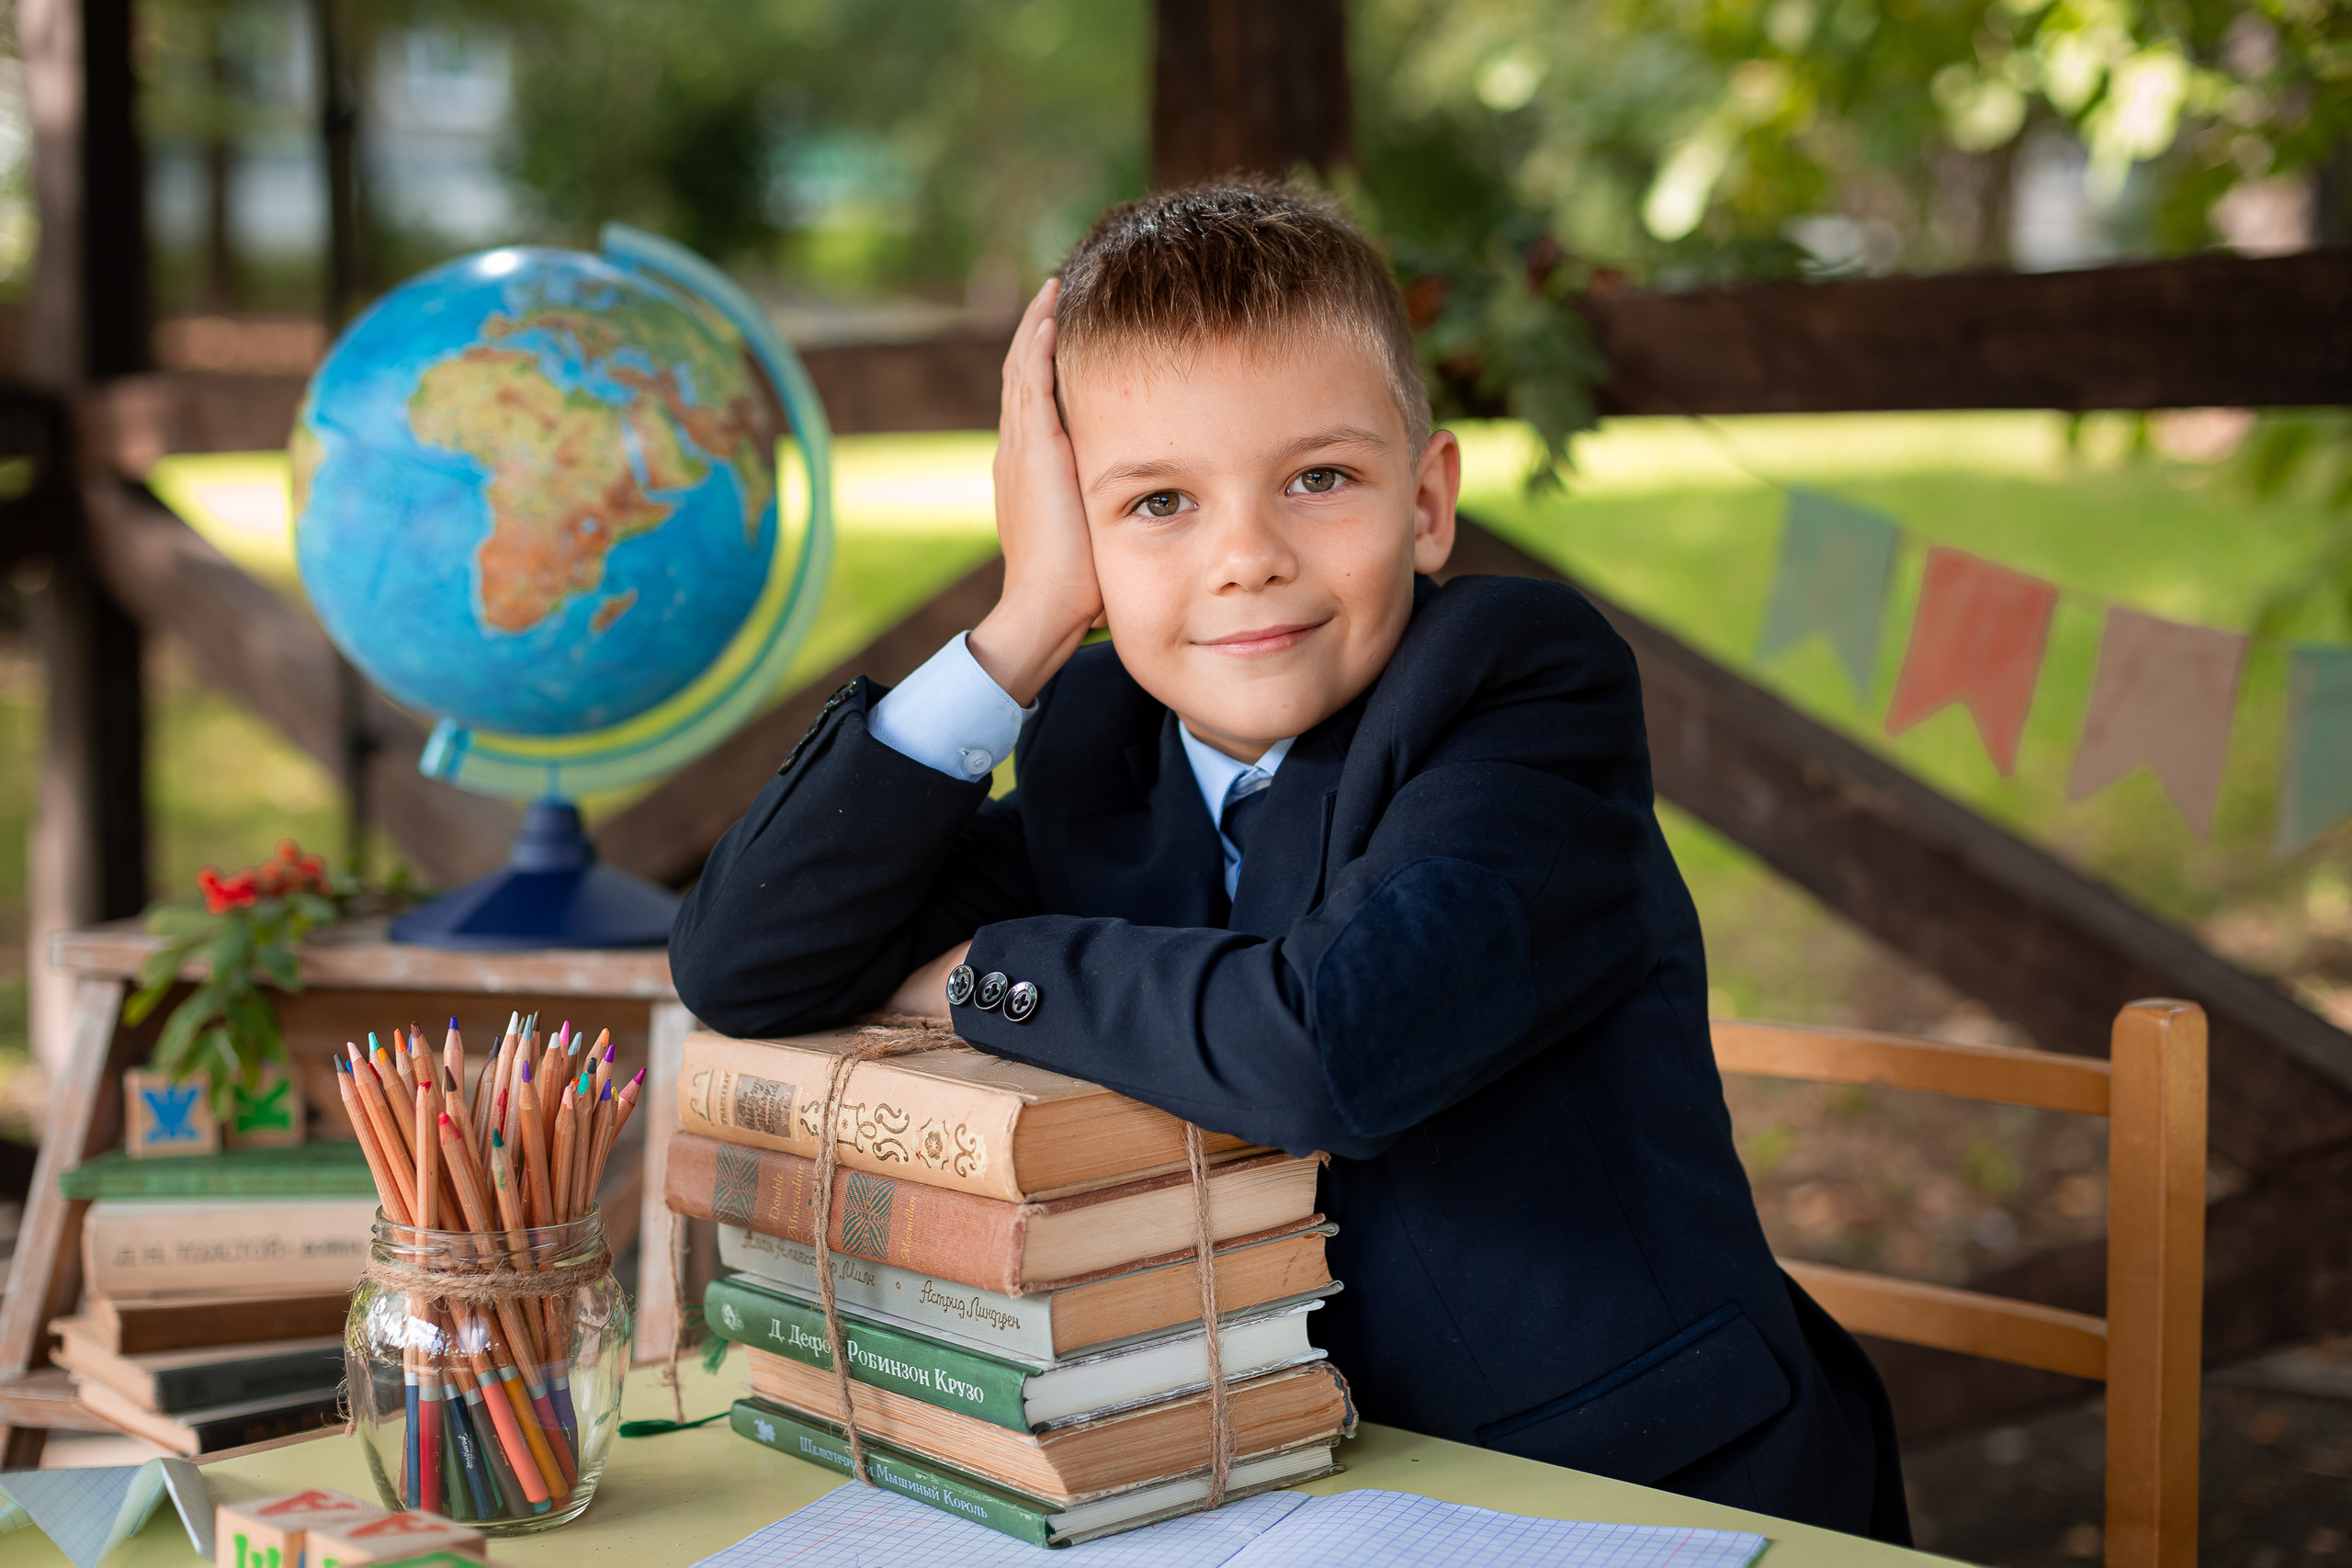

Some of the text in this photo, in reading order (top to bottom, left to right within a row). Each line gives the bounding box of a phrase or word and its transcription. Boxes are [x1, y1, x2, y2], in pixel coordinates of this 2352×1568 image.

[720, 1071, 731, 1125] THACKERAY
[768, 1173, 784, 1221] Double
[786, 1163, 806, 1241] Muscadine
[900, 1195, 917, 1263] Macmillan
[839, 1260, 876, 1286] Милн
[920, 1280, 965, 1319] Астрид
[967, 1296, 1021, 1330] Линдгрен
[768, 1318, 831, 1358] Д. Дефо
[799, 1436, 859, 1470] Щелкунчи
[876, 1463, 940, 1501] Мышиный
[943, 1489, 989, 1518] Король
